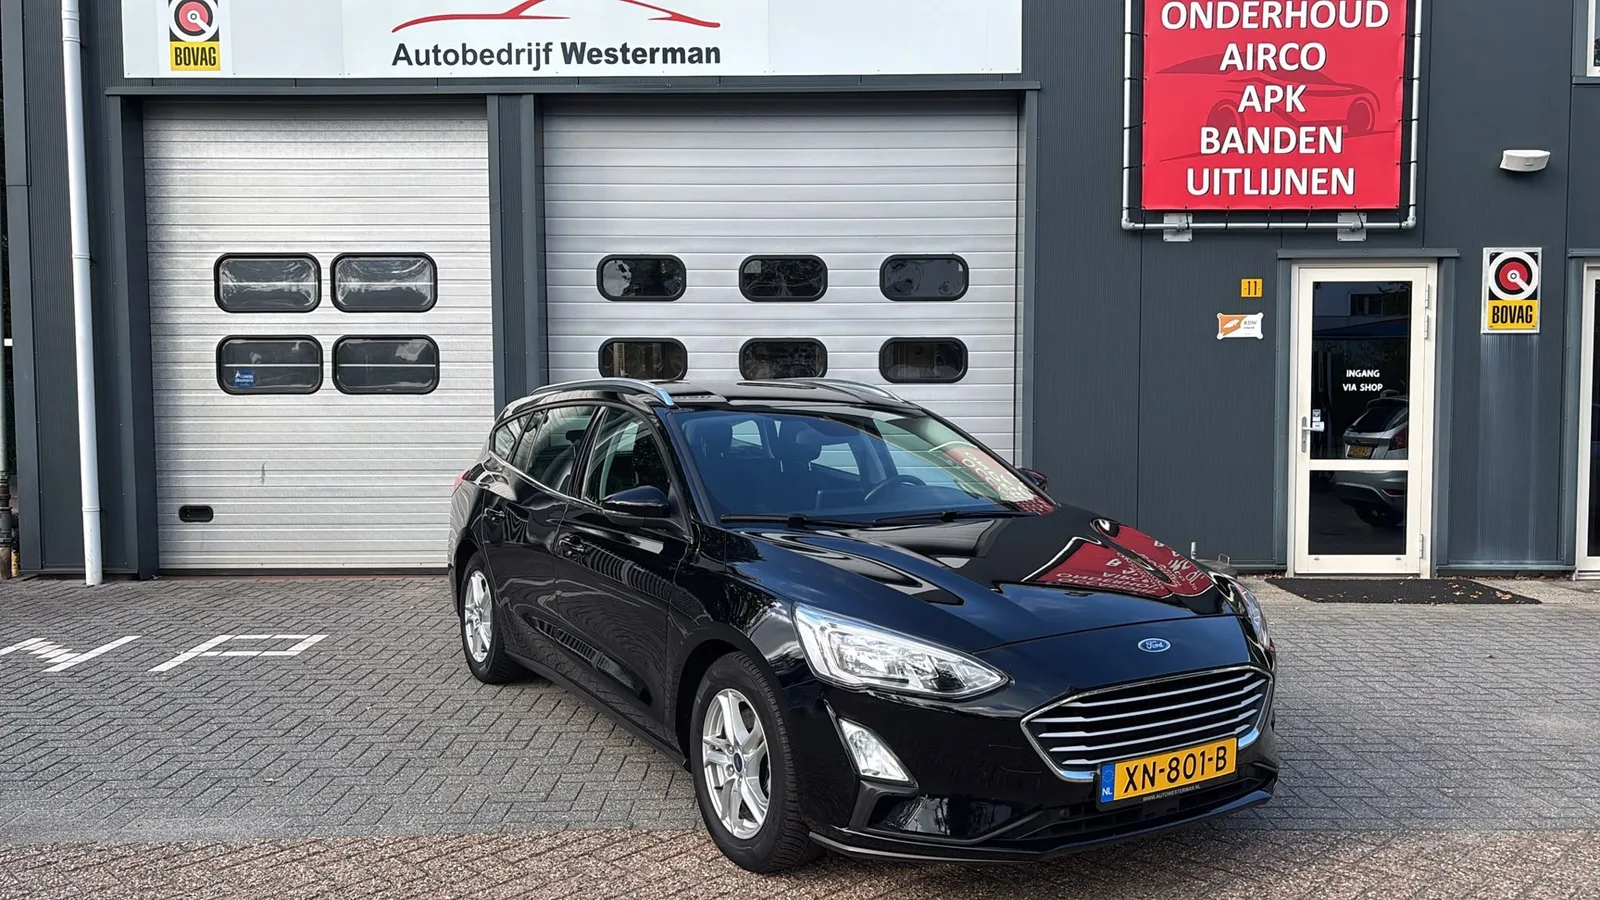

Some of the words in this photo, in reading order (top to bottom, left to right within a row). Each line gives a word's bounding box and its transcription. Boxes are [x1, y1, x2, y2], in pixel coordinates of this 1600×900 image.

[1161, 0, 1390, 30] ONDERHOUD
[174, 46, 216, 67] BOVAG
[392, 42, 553, 71] Autobedrijf
[560, 41, 721, 66] Westerman
[1219, 42, 1327, 72] AIRCO
[1237, 84, 1307, 113] APK
[1200, 126, 1343, 155] BANDEN
[1186, 167, 1355, 196] UITLIJNEN
[1247, 280, 1257, 296] 11
[1491, 304, 1533, 324] BOVAG
[1346, 369, 1381, 378] INGANG
[1342, 383, 1357, 392] VIA
[1359, 383, 1384, 392] SHOP
[1145, 640, 1165, 650] Ford
[1123, 745, 1228, 794] XN-801-B
[1102, 786, 1113, 797] NL
